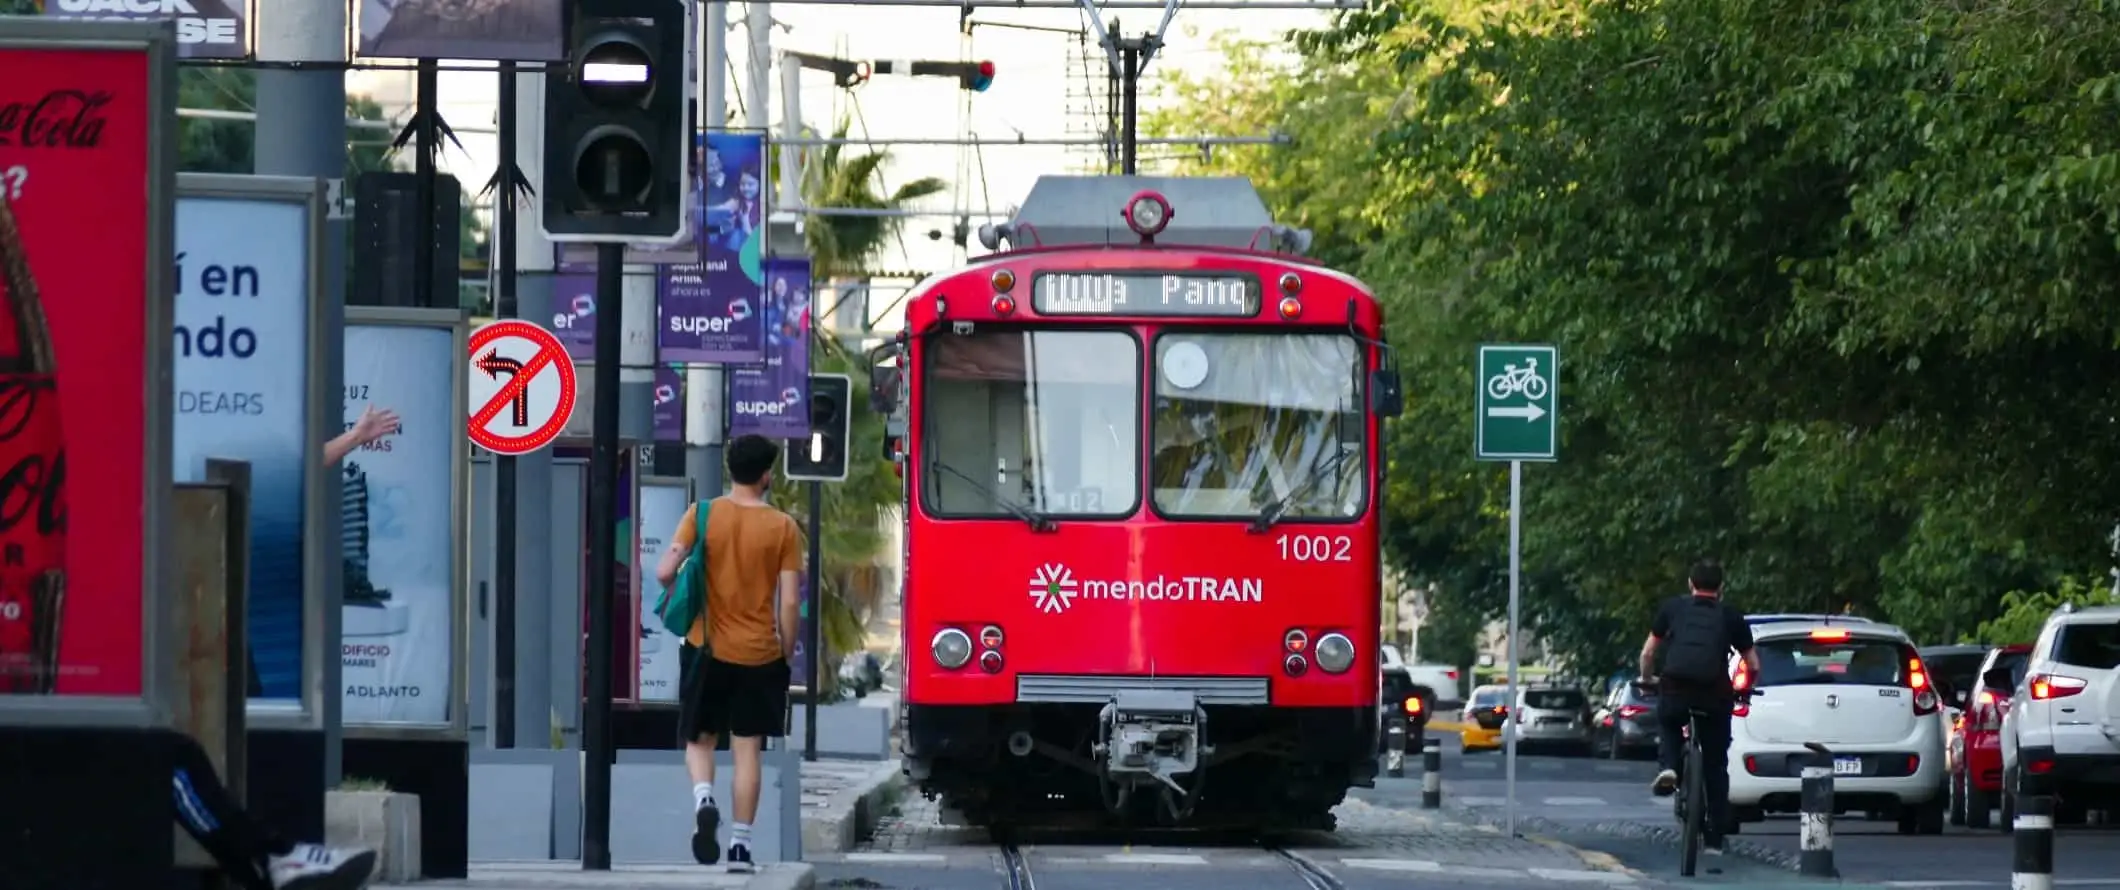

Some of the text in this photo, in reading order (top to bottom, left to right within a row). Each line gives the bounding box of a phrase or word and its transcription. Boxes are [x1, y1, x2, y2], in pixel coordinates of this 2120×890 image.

[201, 264, 259, 297] en
[670, 316, 733, 336] super
[344, 385, 369, 400] UZ
[179, 391, 264, 415] DEARS
[735, 401, 786, 416] super
[1276, 535, 1352, 562] 1002
[1083, 574, 1262, 603] mendoTRAN
[343, 644, 390, 658] DIFICIO
[346, 684, 421, 698] ADLANTO
